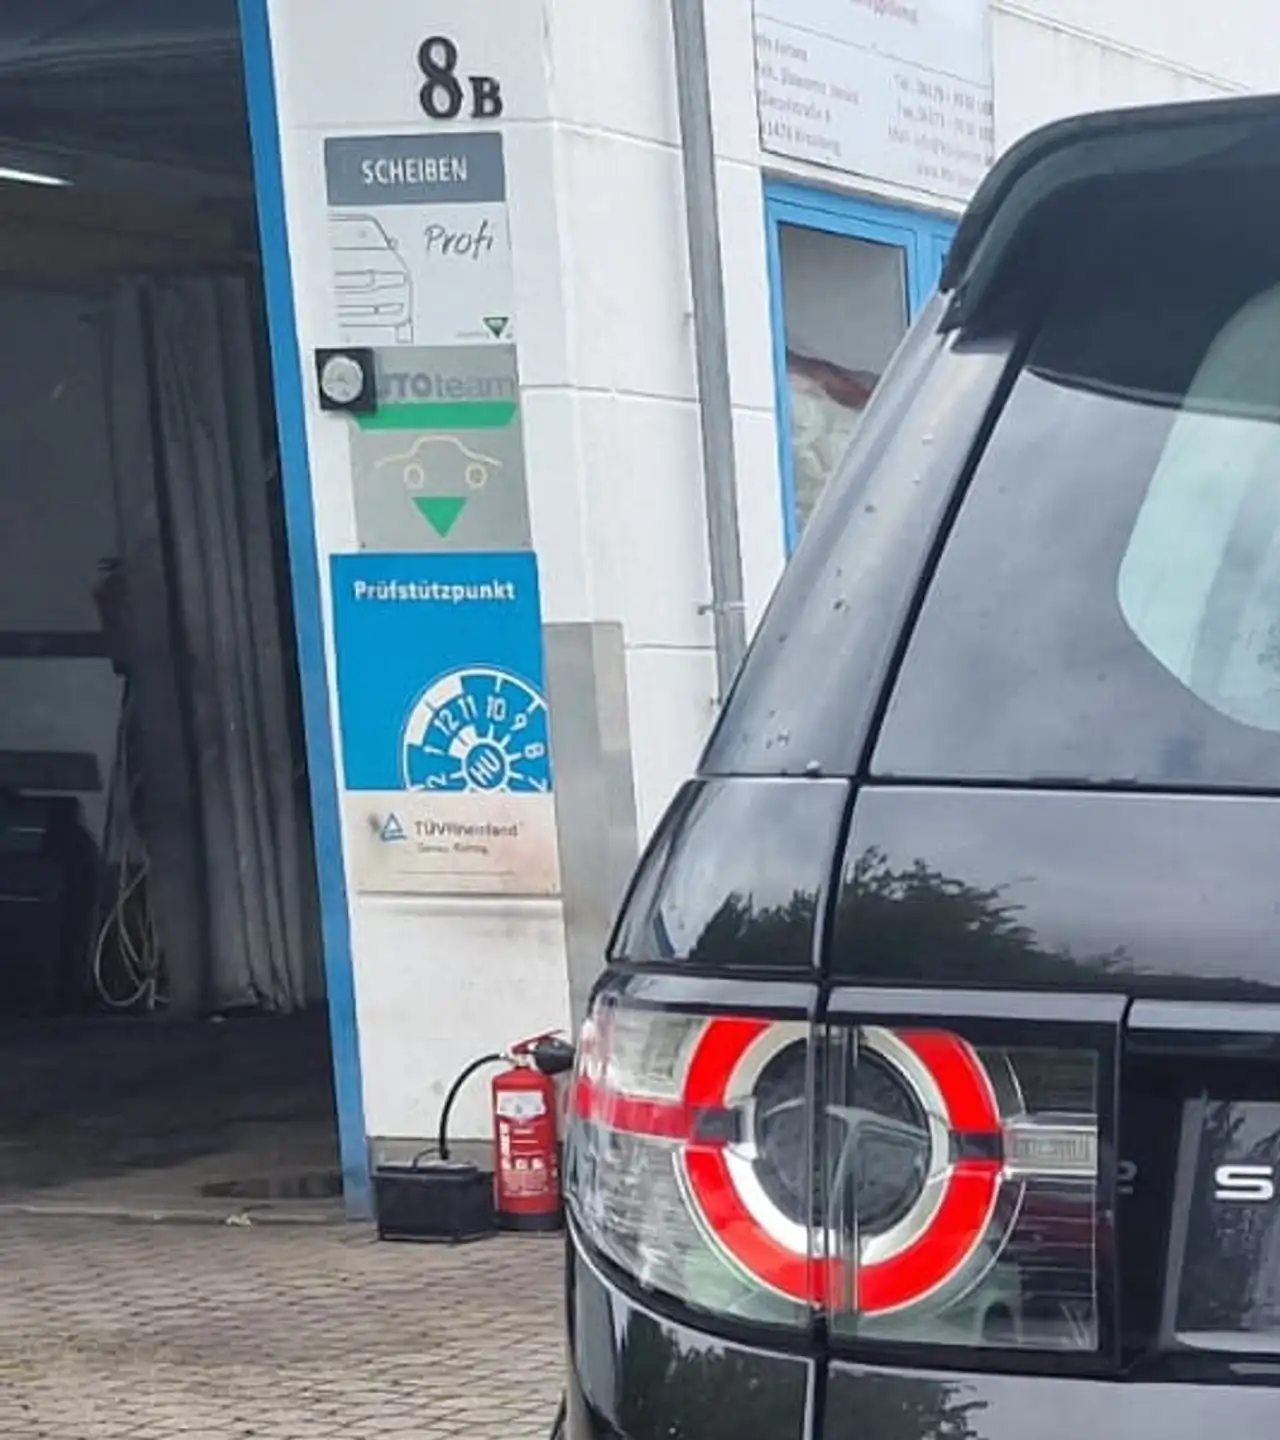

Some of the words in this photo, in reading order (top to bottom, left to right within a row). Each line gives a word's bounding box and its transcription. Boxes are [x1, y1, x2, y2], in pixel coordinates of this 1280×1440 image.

[361, 156, 468, 184] SCHEIBEN
[425, 219, 494, 260] Profi
[353, 579, 516, 606] Prüfstützpunkt
[435, 710, 460, 735] 12
[458, 695, 479, 720] 11
[487, 696, 507, 721] 10
[510, 713, 529, 732] 9
[524, 743, 546, 759] 8
[470, 749, 501, 786] HU
